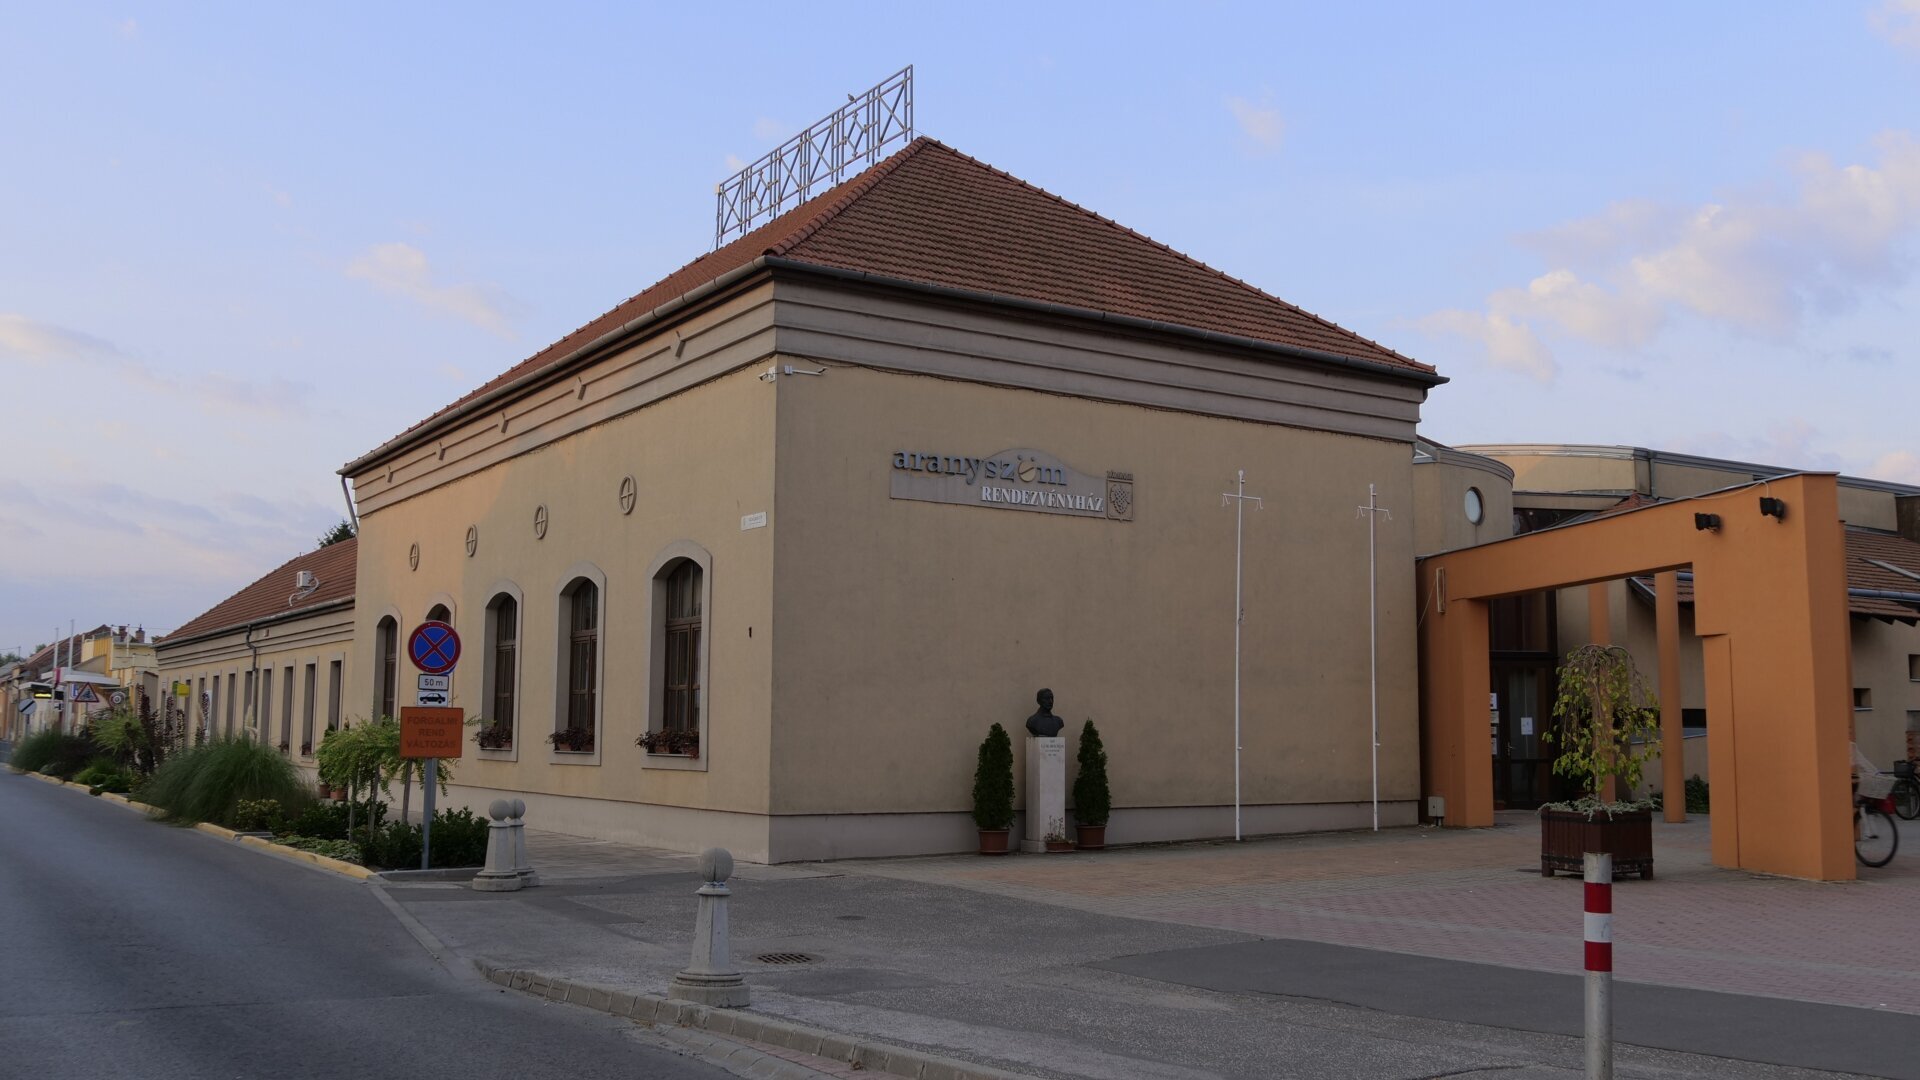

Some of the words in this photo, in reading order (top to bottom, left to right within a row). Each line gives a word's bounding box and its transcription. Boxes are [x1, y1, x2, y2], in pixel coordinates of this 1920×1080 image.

[981, 486, 1103, 512] RENDEZVÉNYHÁZ
[424, 678, 434, 686] 50
[407, 716, 458, 725] FORGALMI
[418, 728, 445, 737] REND
